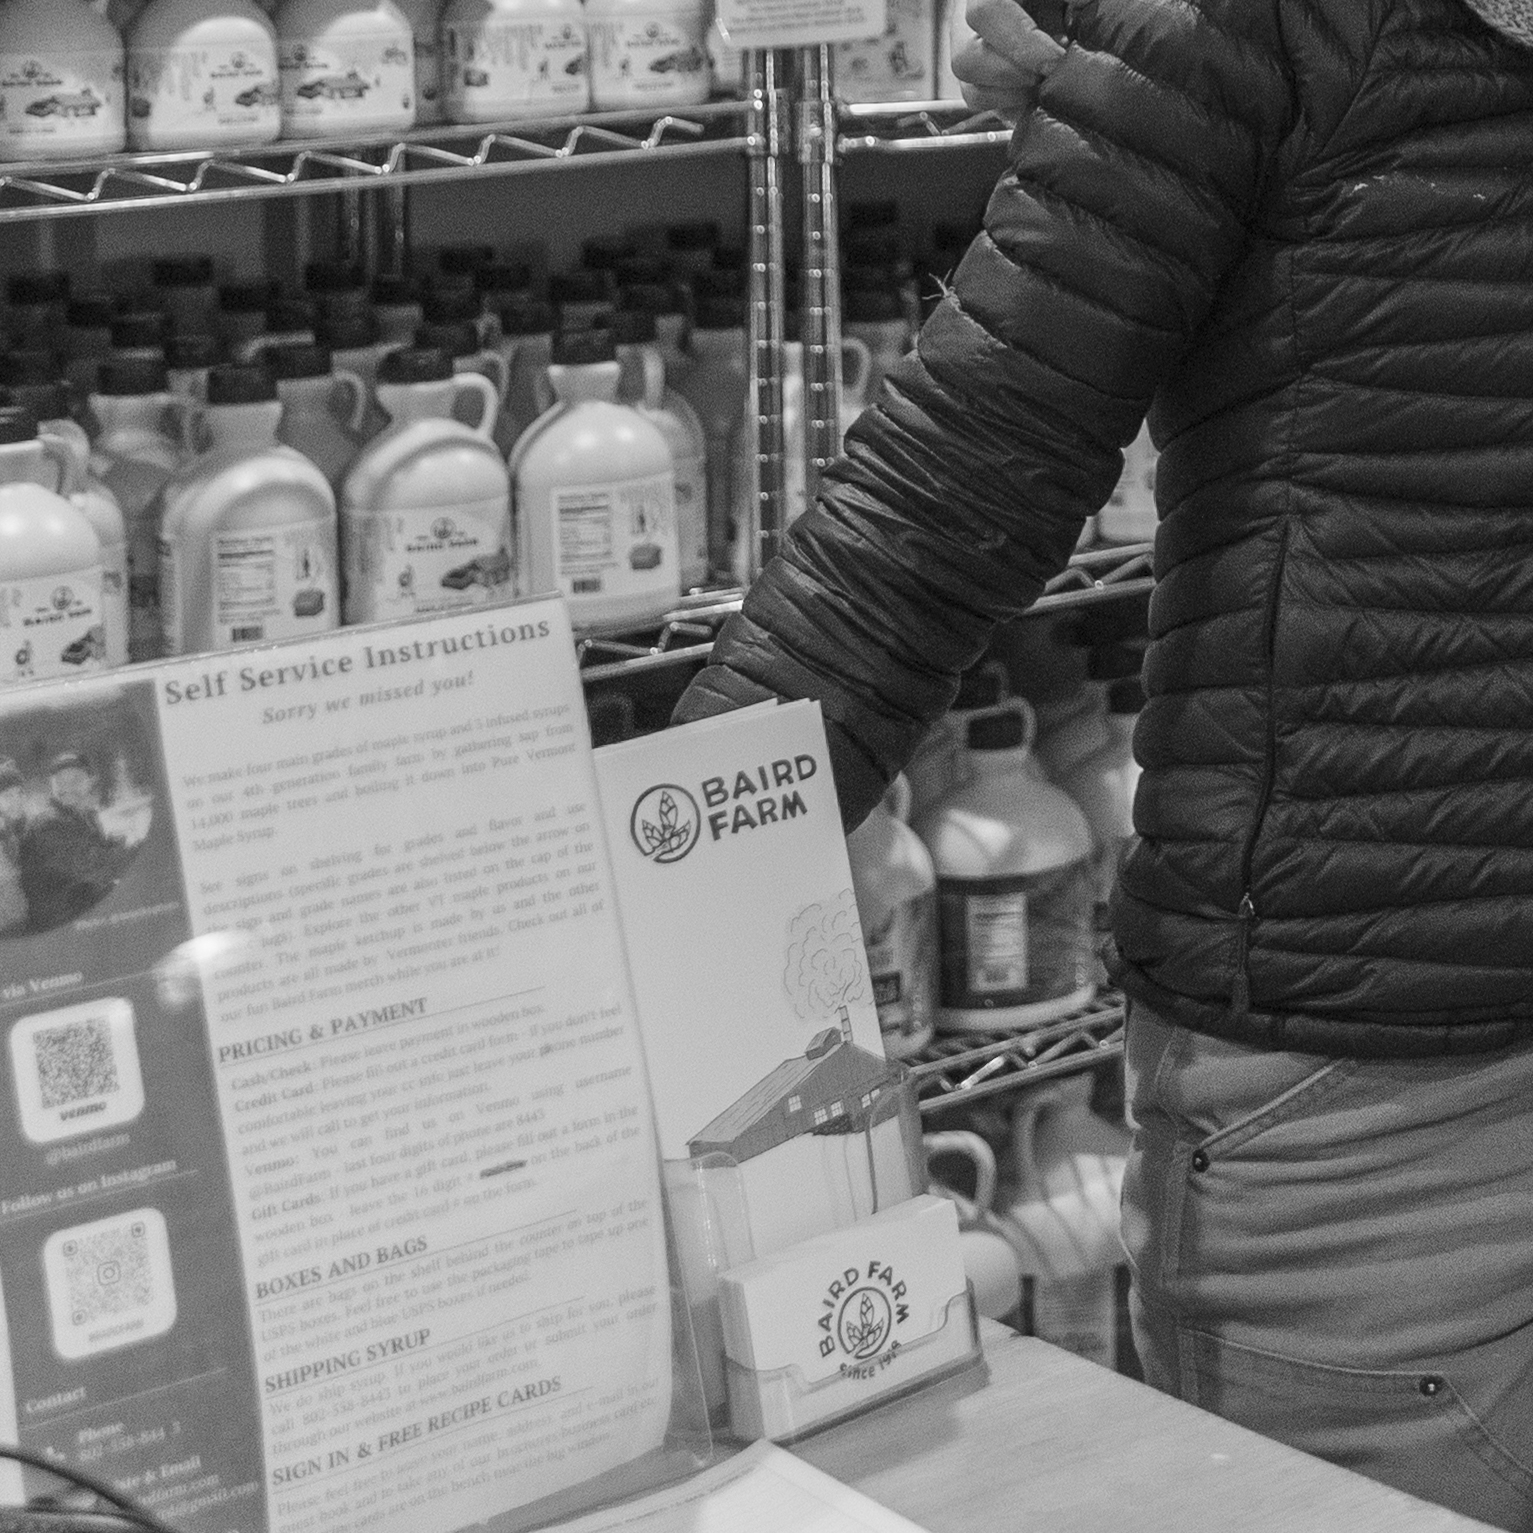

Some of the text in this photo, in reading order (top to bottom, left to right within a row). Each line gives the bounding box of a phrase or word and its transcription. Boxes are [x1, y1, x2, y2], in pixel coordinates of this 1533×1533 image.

[164, 619, 551, 706] Self Service Instructions
[261, 670, 475, 724] Sorry we missed you!
[701, 754, 817, 808] BAIRD
[708, 790, 808, 841] FARM
[30, 972, 83, 993] Venmo
[218, 997, 428, 1064] PRICING & PAYMENT
[60, 1101, 107, 1121] venmo
[1, 1160, 176, 1215] Follow us on Instagram
[256, 1236, 428, 1299] BOXES AND BAGS
[818, 1261, 909, 1358] BAIRD FARM
[264, 1328, 430, 1394] SHIPPING SYRUP
[840, 1362, 875, 1380] Since
[26, 1387, 86, 1413] Contact
[272, 1375, 562, 1487] SIGN IN & FREE RECIPE CARDS
